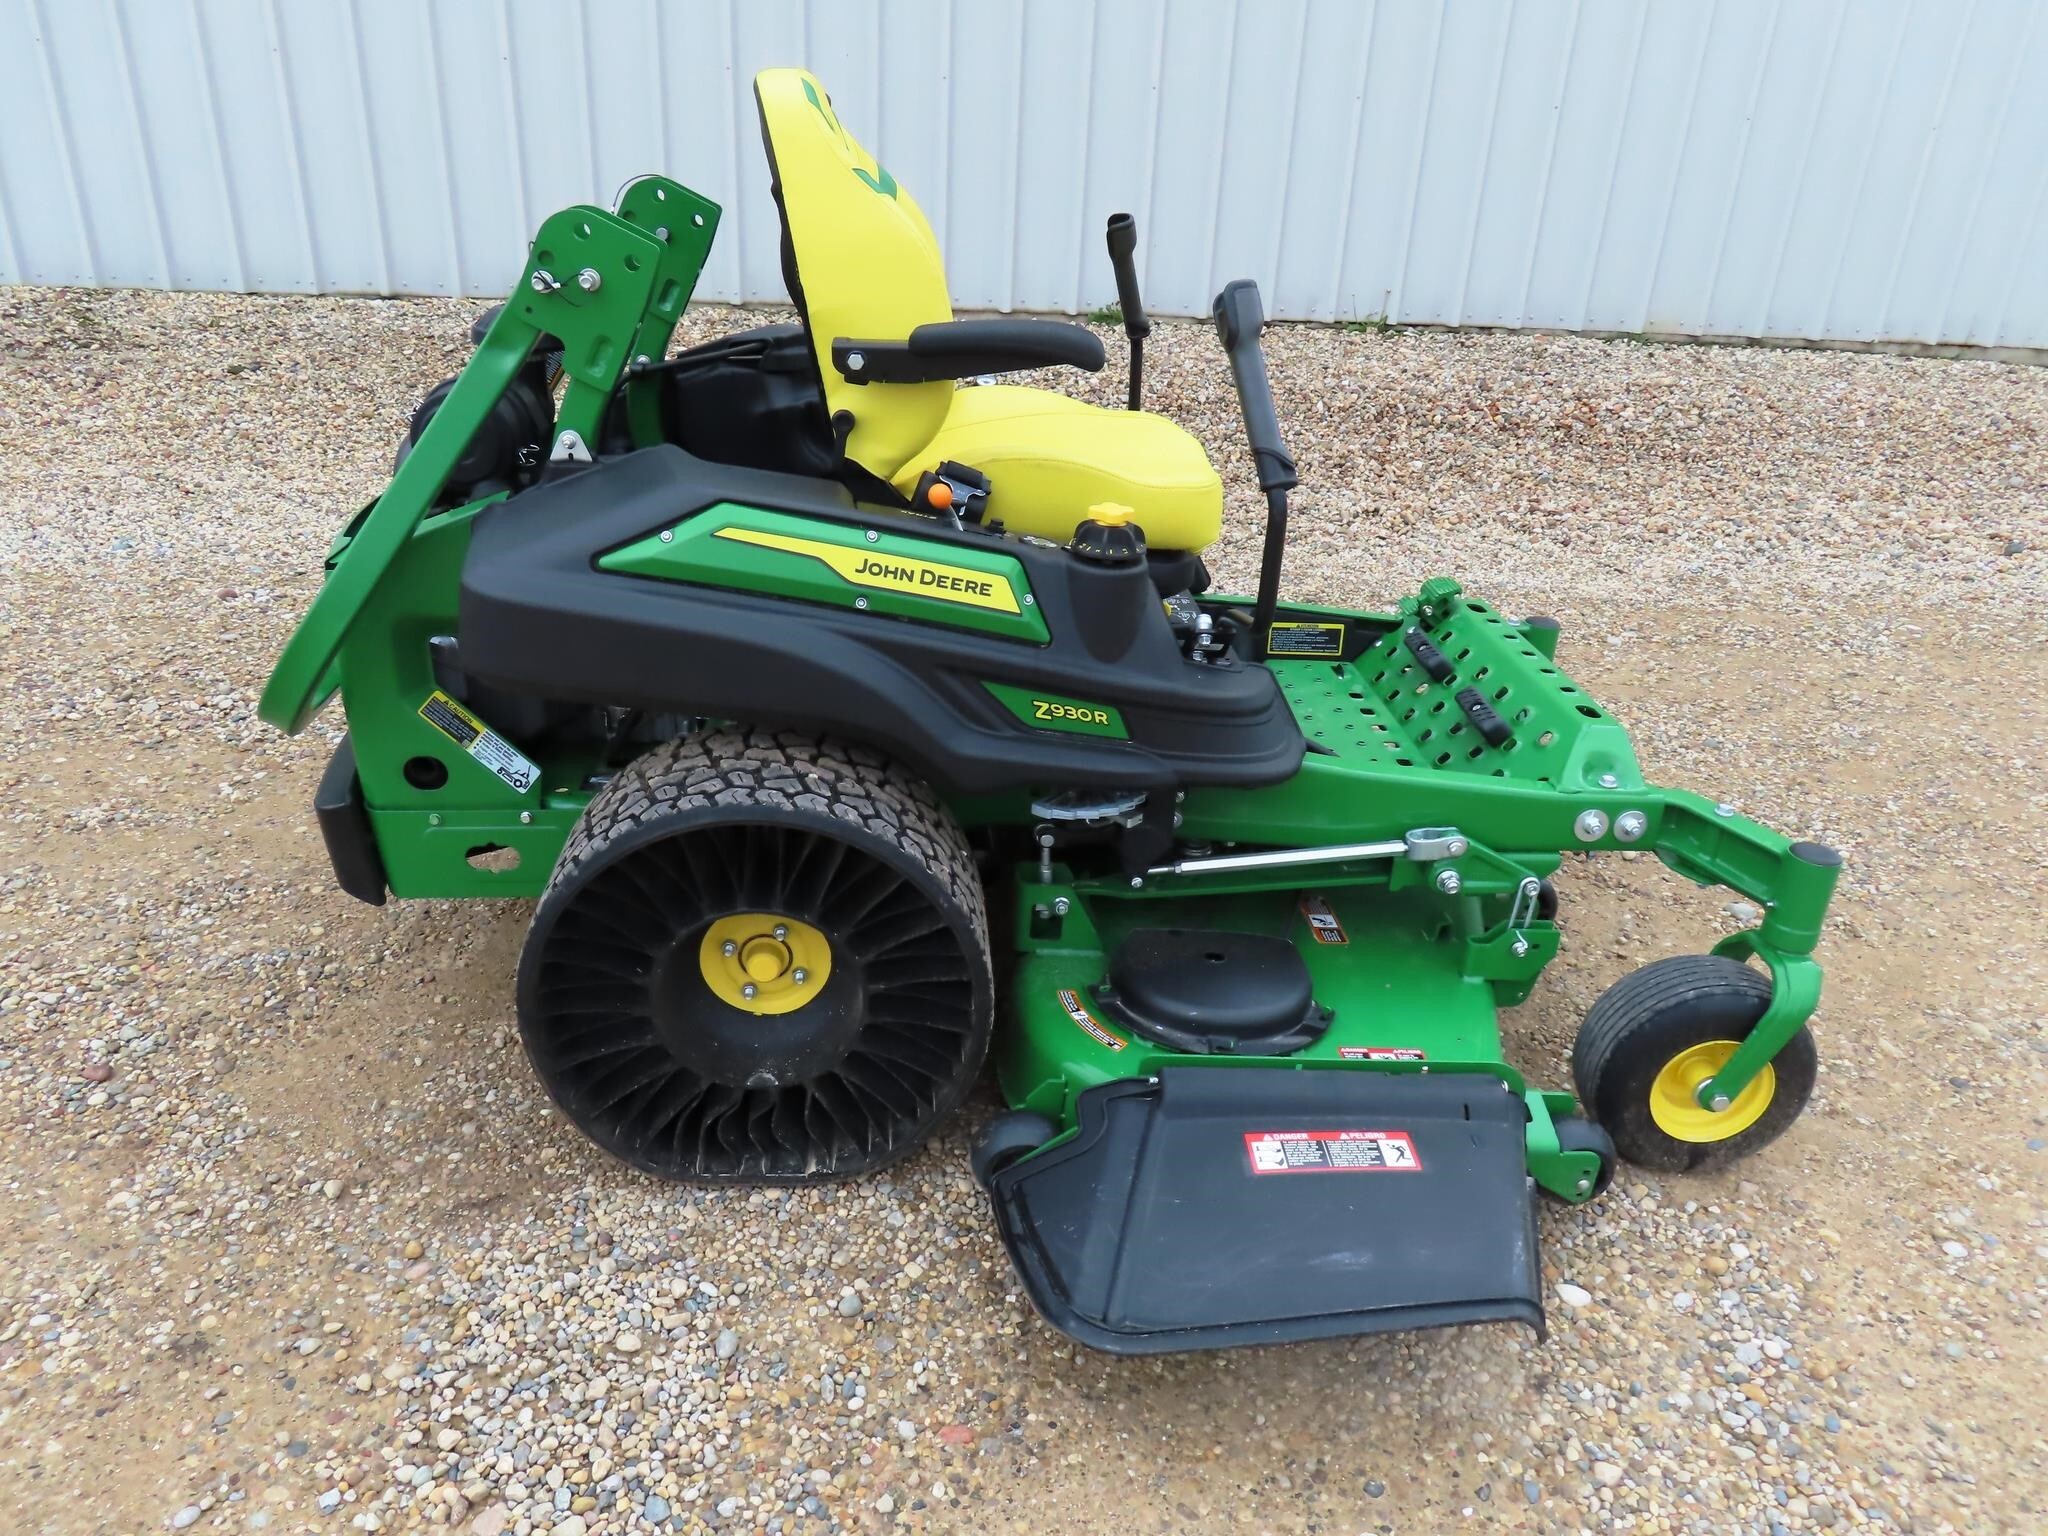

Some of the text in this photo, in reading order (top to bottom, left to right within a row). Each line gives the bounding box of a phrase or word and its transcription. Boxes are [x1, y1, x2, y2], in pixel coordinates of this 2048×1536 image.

[855, 558, 993, 598] JOHN DEERE
[448, 703, 474, 724] CAUTION
[1032, 700, 1109, 725] Z930R
[1272, 1132, 1309, 1141] DANGER
[1350, 1131, 1387, 1140] PELIGRO
